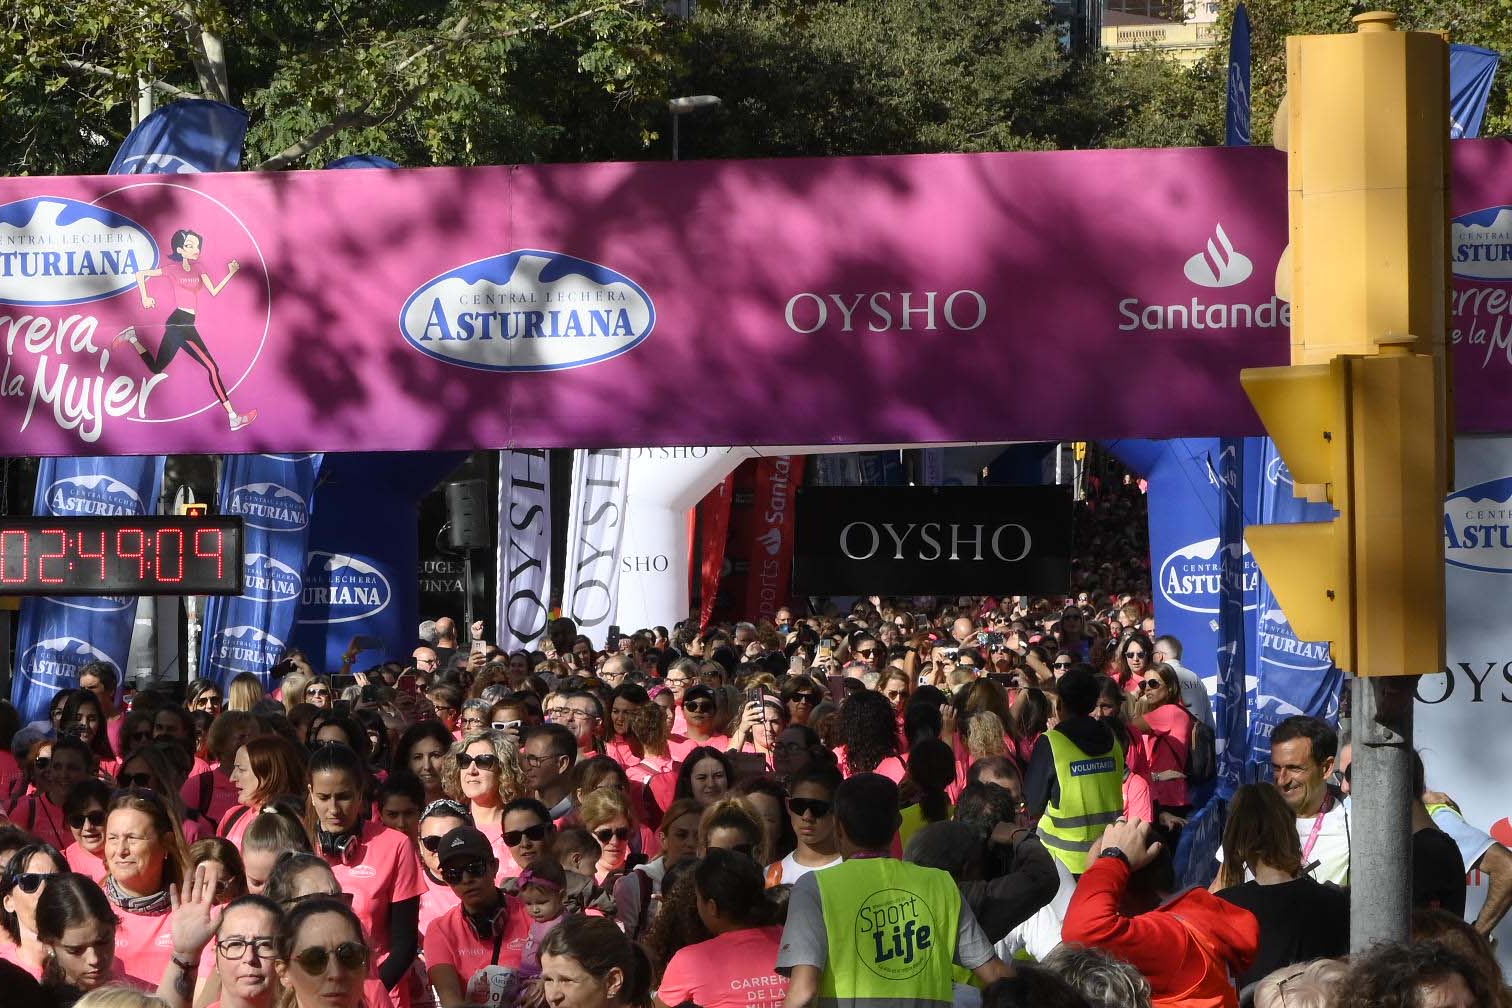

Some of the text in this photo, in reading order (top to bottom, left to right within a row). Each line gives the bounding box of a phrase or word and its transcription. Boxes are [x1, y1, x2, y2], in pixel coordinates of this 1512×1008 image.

[61, 232, 135, 245] LECHERA
[459, 289, 627, 307] CENTRAL LECHERA
[784, 289, 988, 334] OYSHO
[1118, 295, 1292, 332] Santande
[419, 296, 637, 343] ASTURIANA
[0, 356, 25, 397] la
[20, 348, 169, 442] Mujer
[232, 494, 306, 525] ASTURIANA
[0, 528, 225, 583] 02:49:09
[839, 521, 1033, 562] OYSHO
[860, 896, 919, 933] Sport
[873, 920, 931, 964] Life
[747, 988, 786, 1001] DE LA
